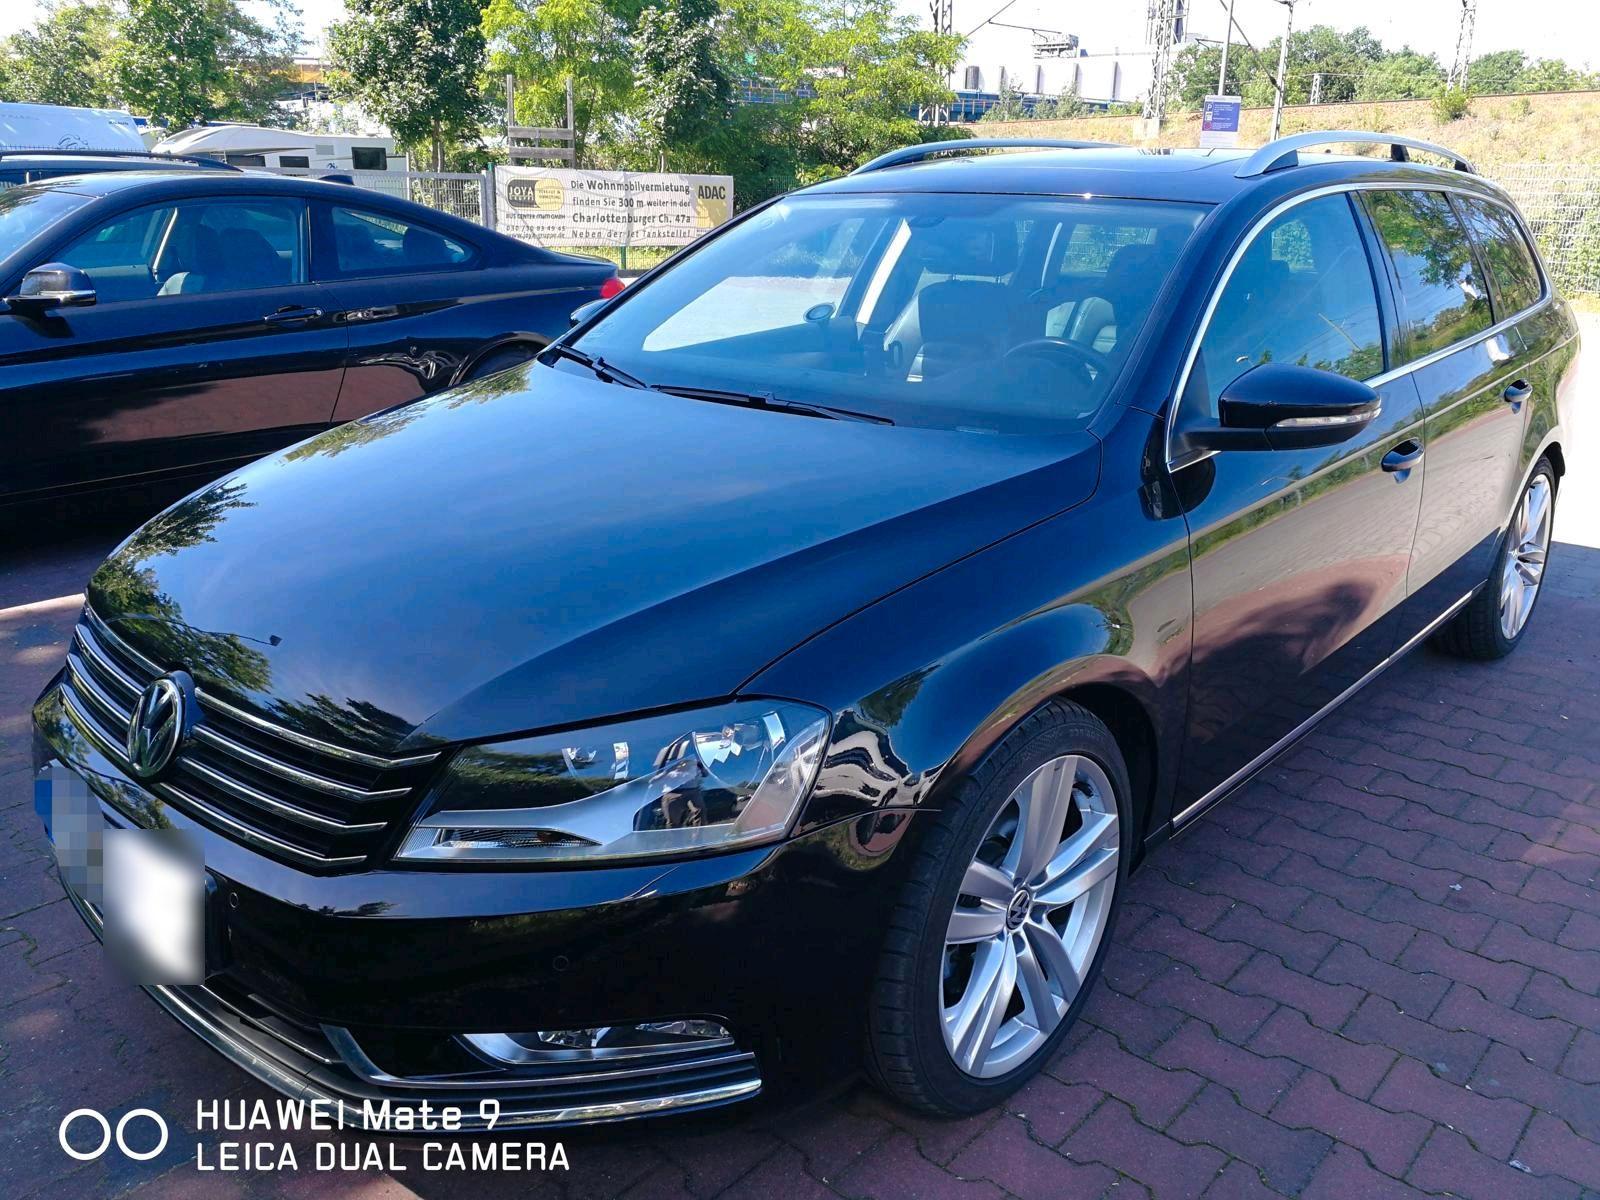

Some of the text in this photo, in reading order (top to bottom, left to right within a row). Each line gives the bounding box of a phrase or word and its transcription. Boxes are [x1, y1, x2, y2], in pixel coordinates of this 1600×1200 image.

[509, 186, 534, 196] JOYA
[571, 180, 690, 195] Die Wohnmobilvermietung
[698, 185, 726, 200] ADAC
[573, 197, 691, 207] finden Sie 300 m weiter in der
[572, 212, 691, 226] Charlottenburger Ch. 47a
[572, 229, 602, 238] Neben
[606, 229, 623, 238] der
[643, 229, 691, 238] Tankstelle!
